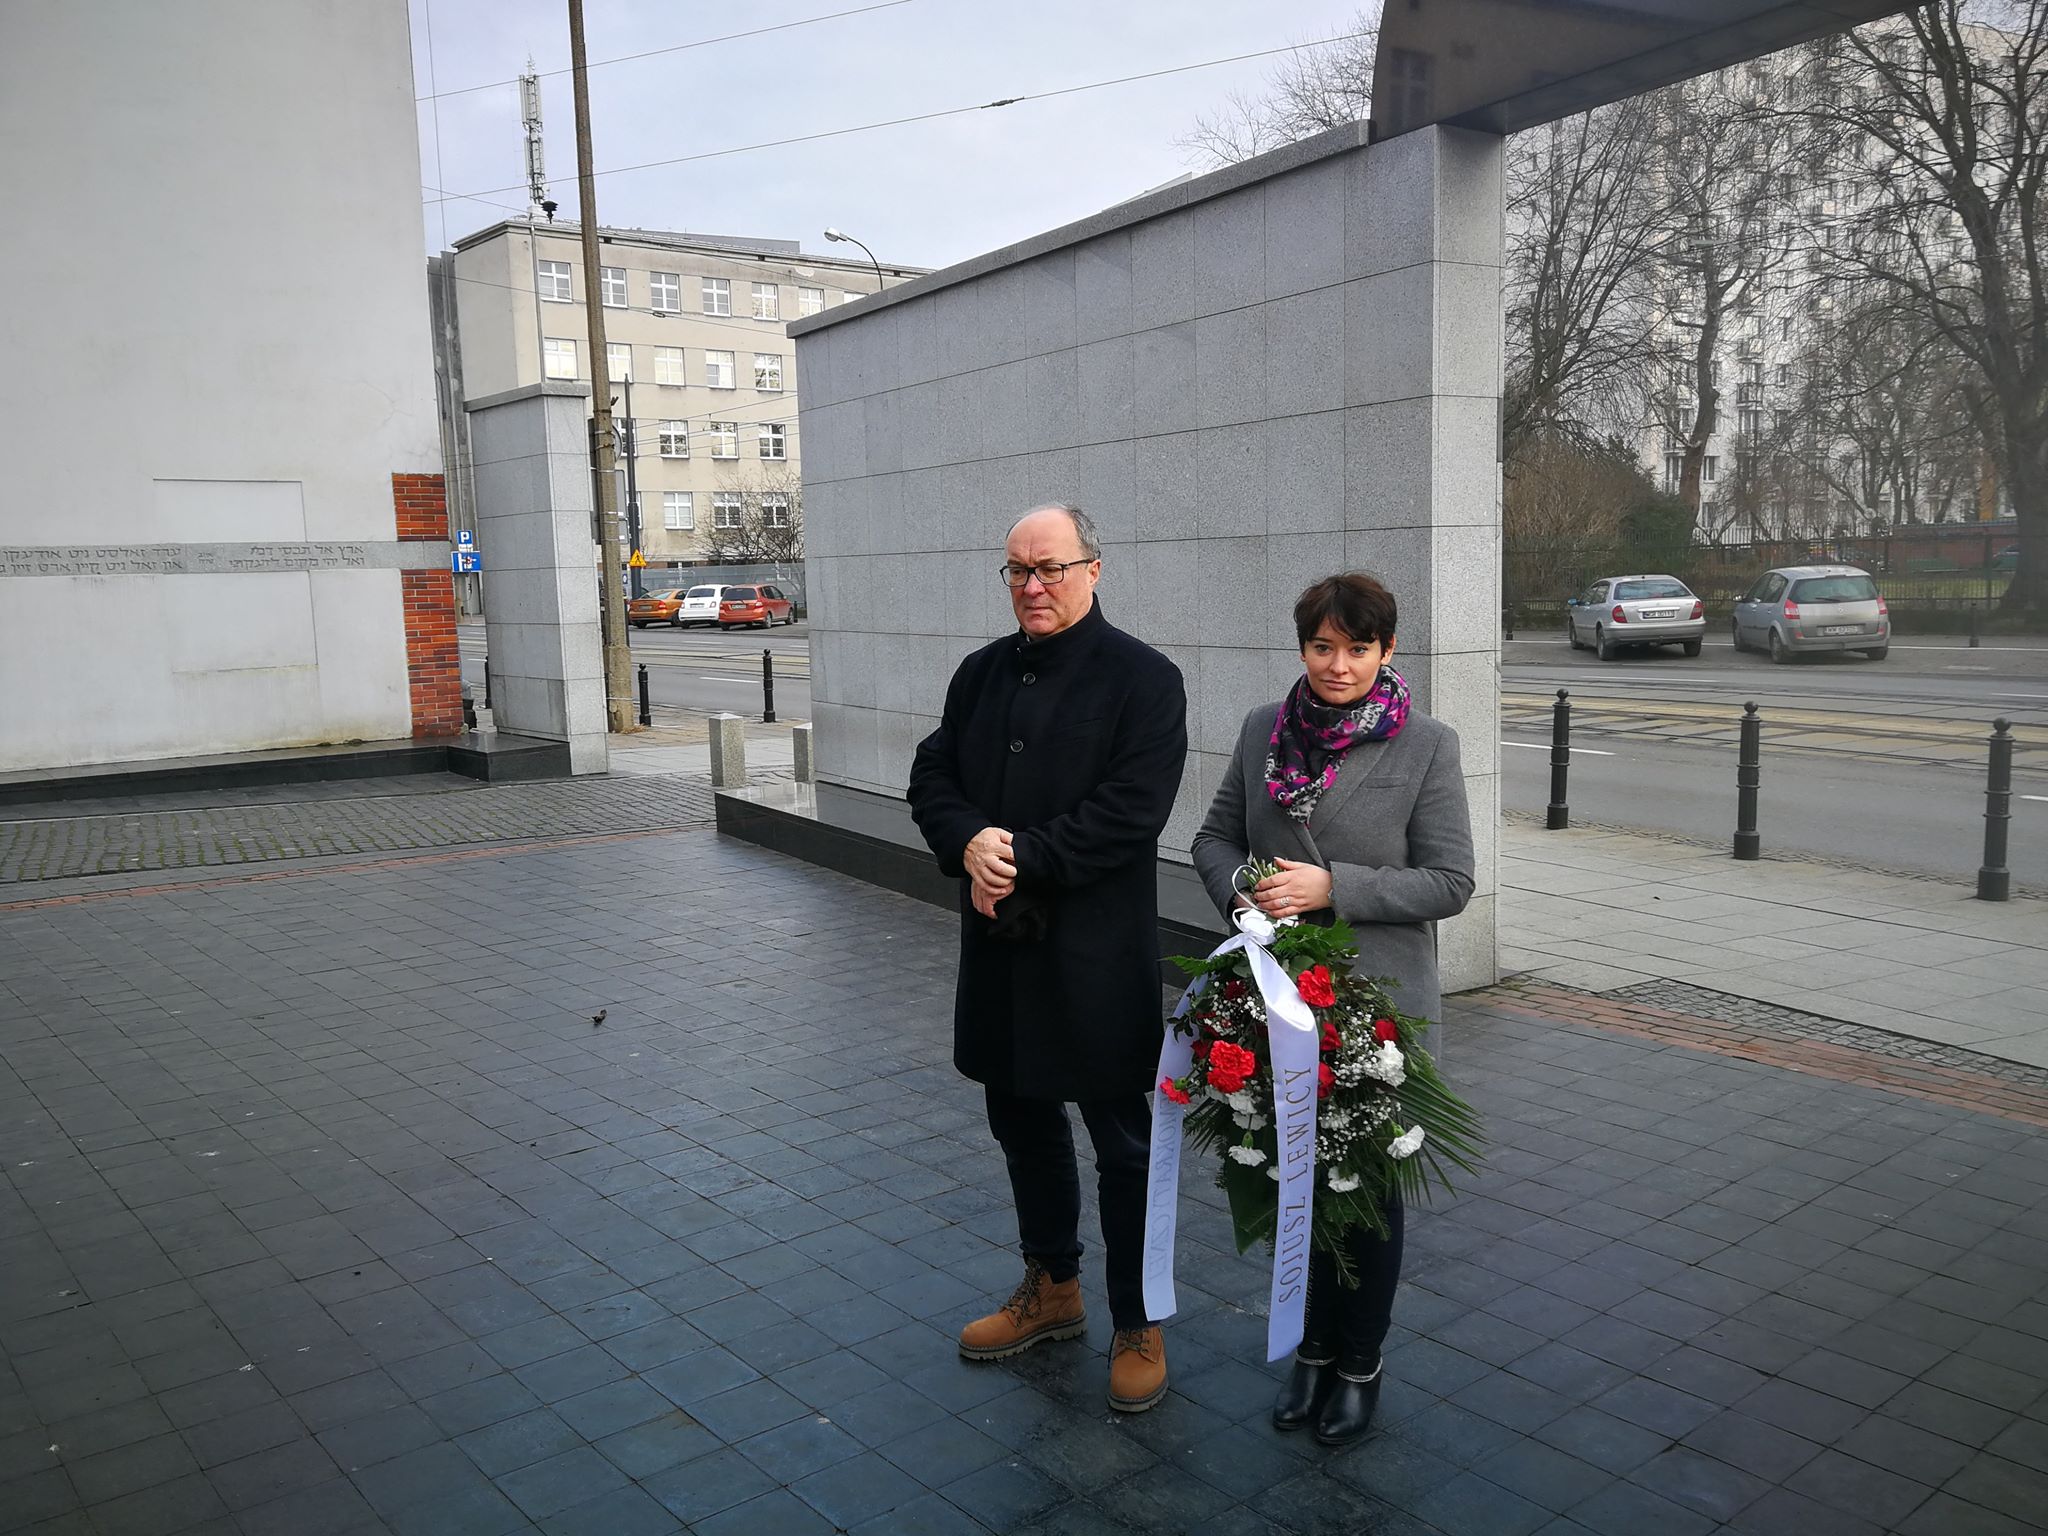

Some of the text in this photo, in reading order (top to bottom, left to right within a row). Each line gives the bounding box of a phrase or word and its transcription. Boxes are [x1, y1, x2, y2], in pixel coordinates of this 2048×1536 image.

[460, 531, 470, 543] P
[338, 545, 364, 558] ארץ
[1278, 1067, 1312, 1304] SOJUSZ LEWICY
